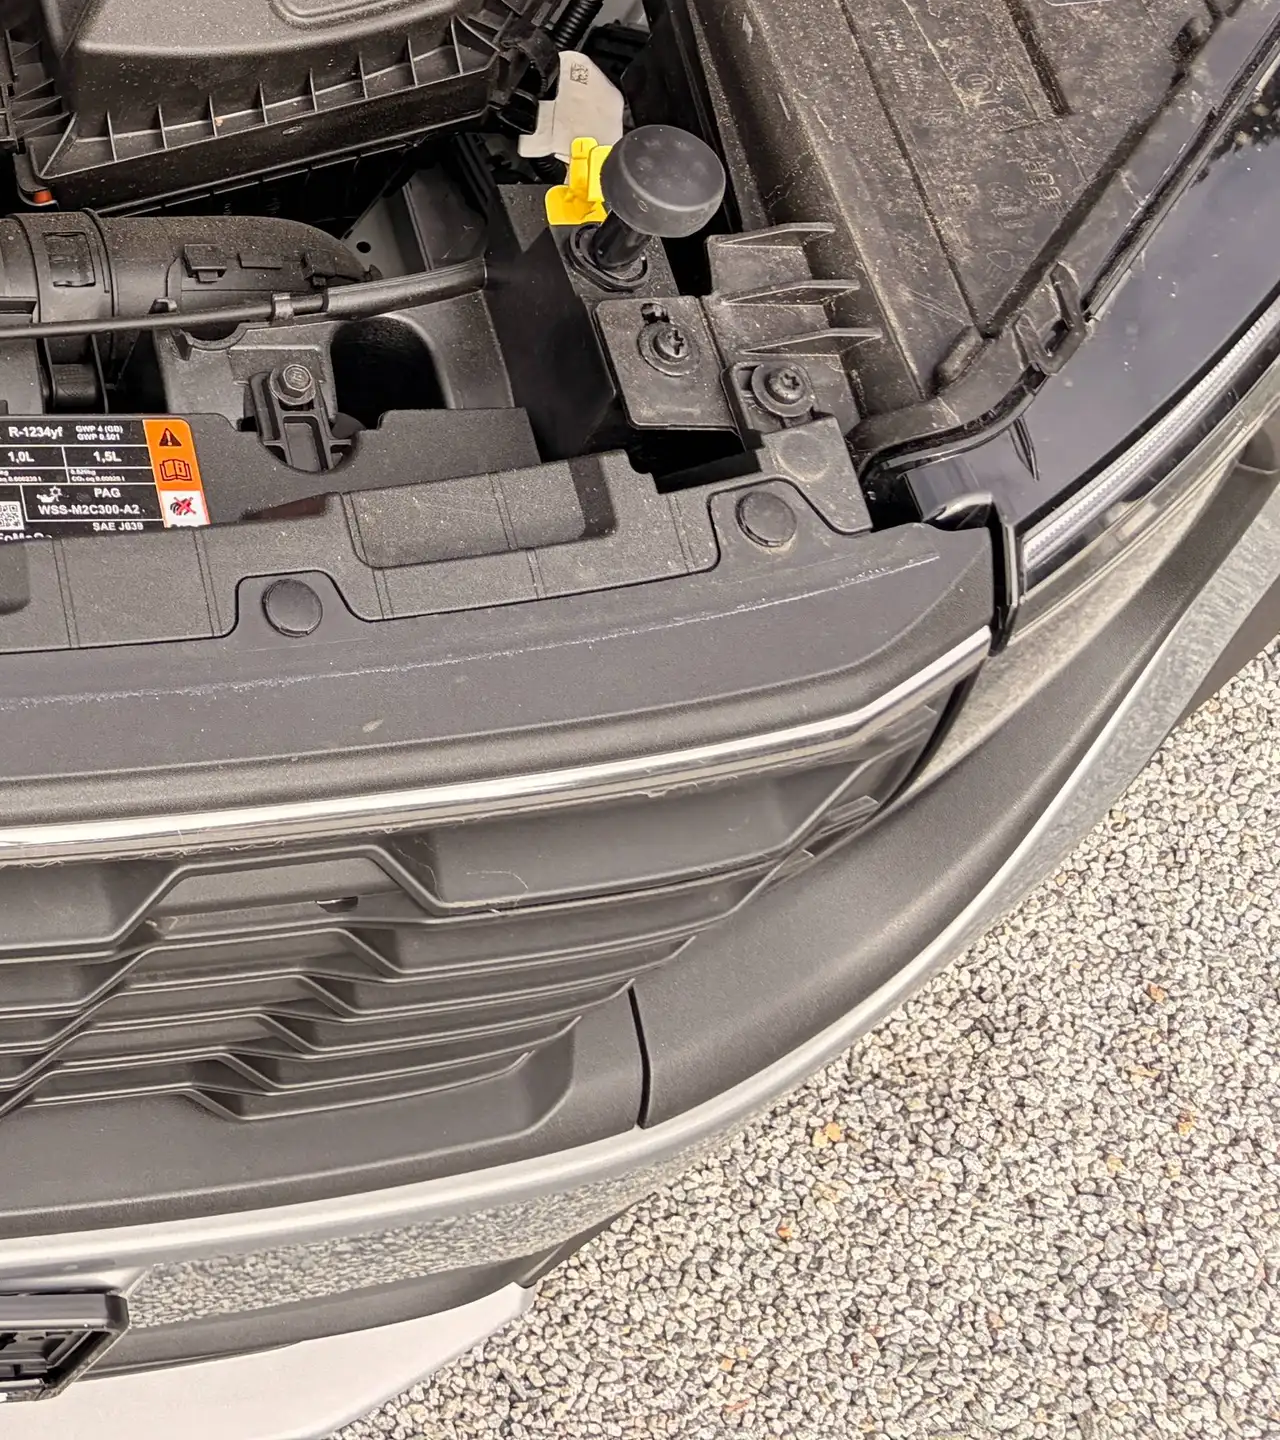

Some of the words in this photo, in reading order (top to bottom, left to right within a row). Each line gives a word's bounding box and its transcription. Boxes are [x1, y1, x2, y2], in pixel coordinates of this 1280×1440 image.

[8, 426, 64, 440] R-1234yf
[7, 451, 35, 463] 1,0L
[93, 451, 122, 463] 1,5L
[94, 488, 121, 498] PAG
[38, 504, 140, 515] WSS-M2C300-A2
[93, 522, 116, 531] SAE
[118, 521, 144, 531] J639
